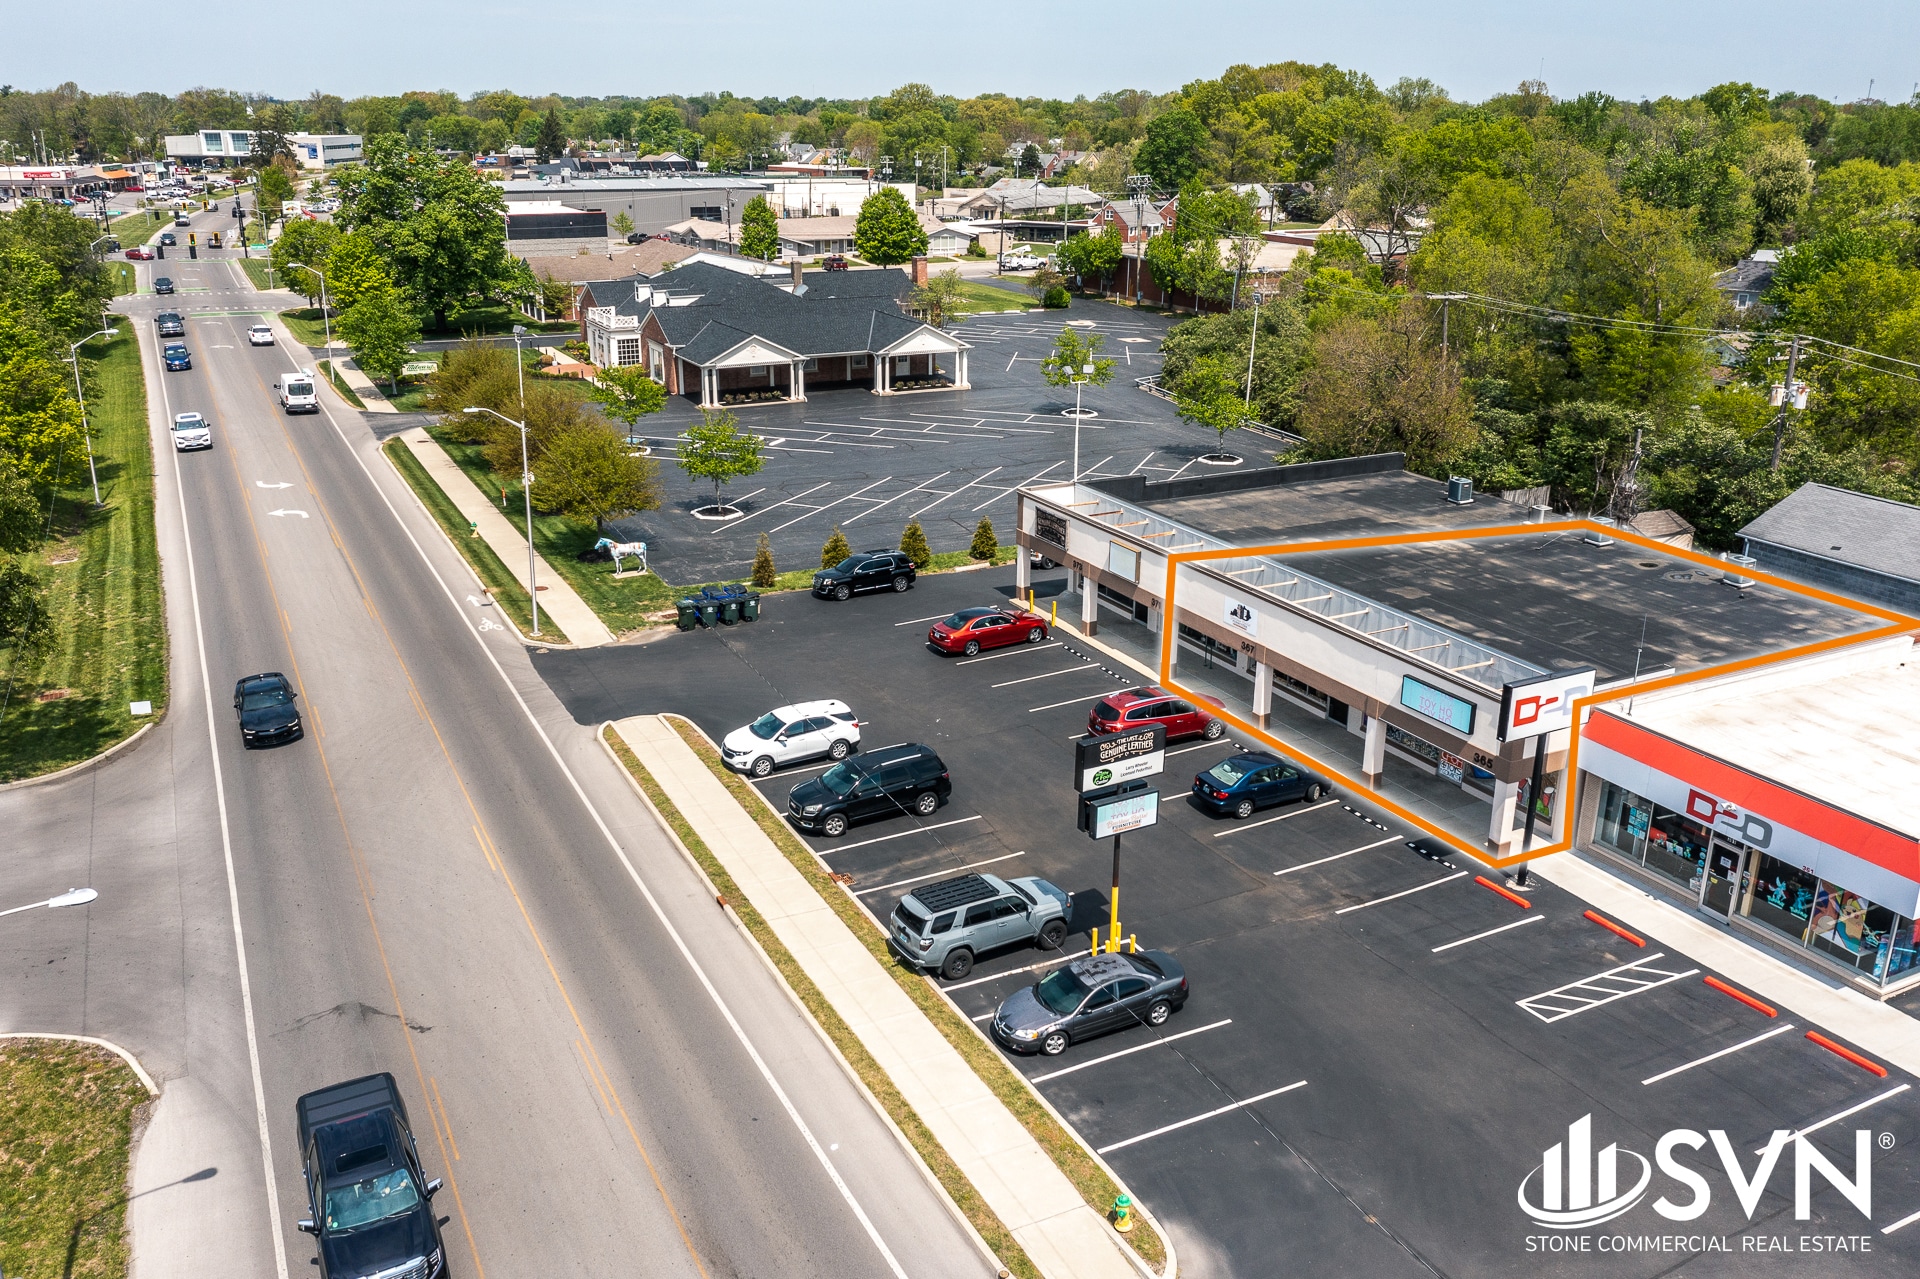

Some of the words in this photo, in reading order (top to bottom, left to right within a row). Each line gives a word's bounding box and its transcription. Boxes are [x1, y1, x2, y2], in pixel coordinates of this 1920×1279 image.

[1072, 560, 1083, 571] 373
[1241, 641, 1255, 653] 367
[1420, 696, 1437, 710] TOY
[1100, 743, 1128, 759] GENUINE
[1128, 740, 1154, 751] LEATHER
[1473, 752, 1494, 769] 365
